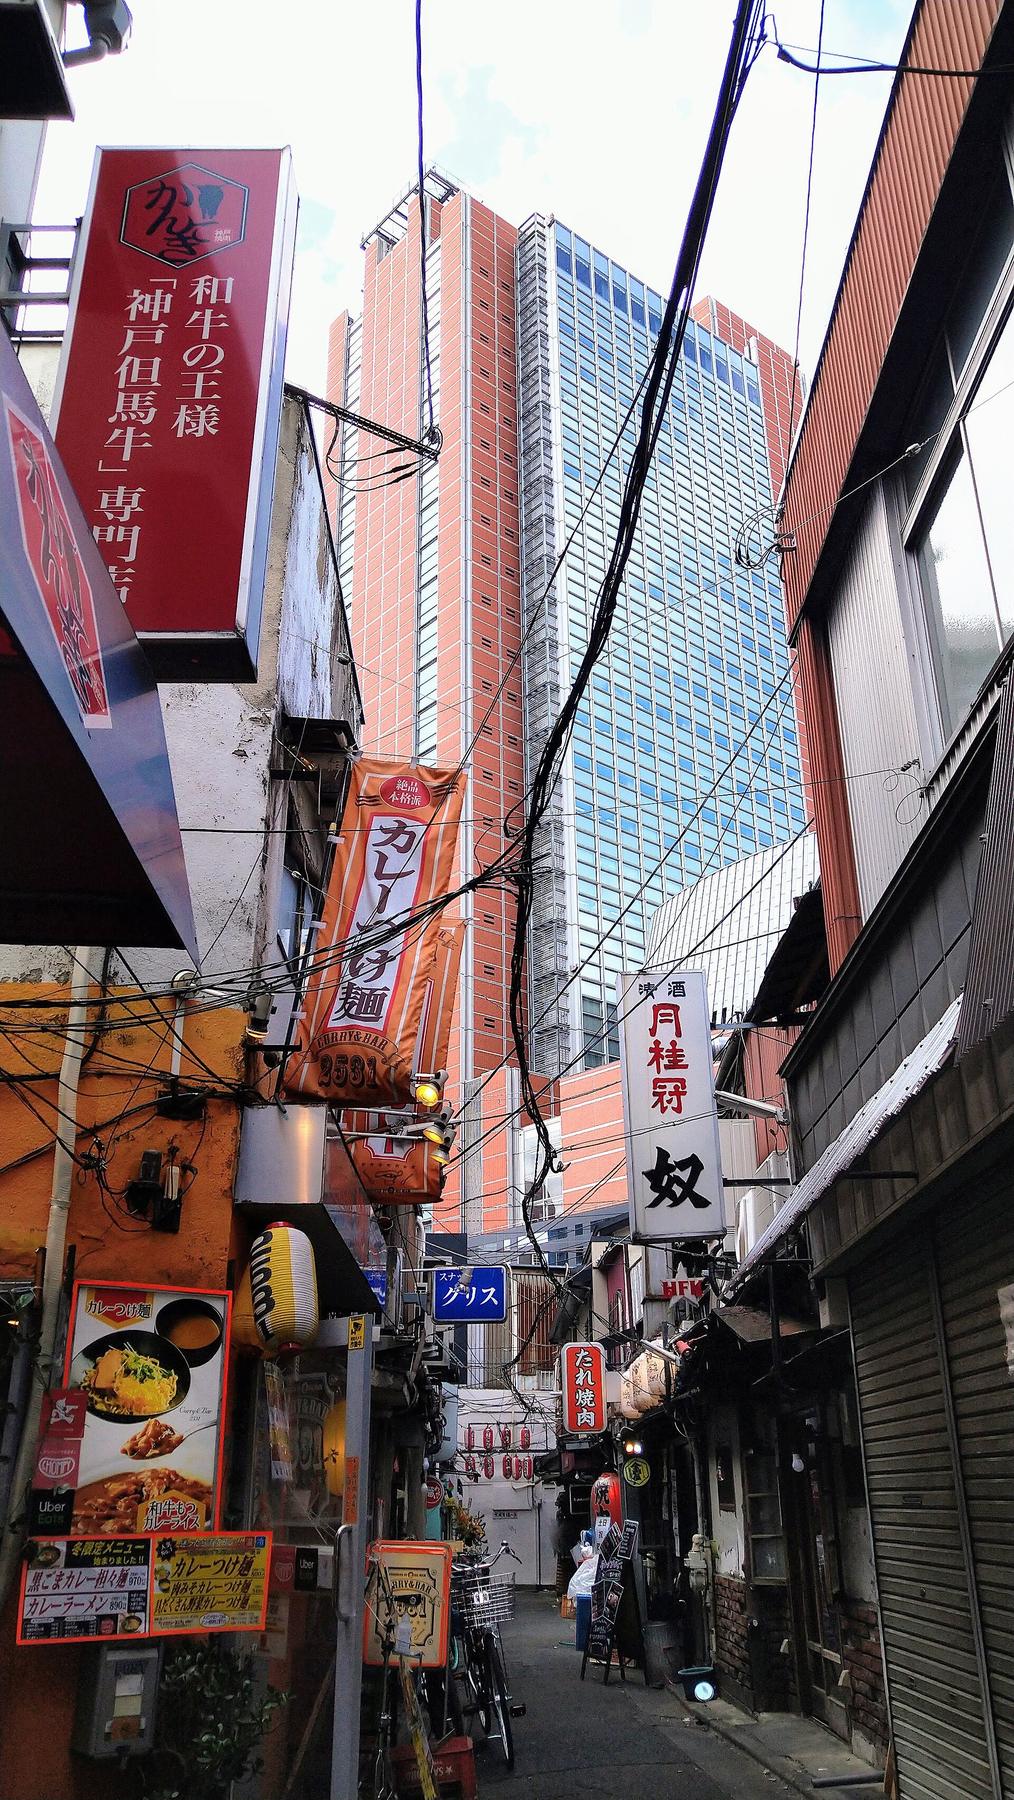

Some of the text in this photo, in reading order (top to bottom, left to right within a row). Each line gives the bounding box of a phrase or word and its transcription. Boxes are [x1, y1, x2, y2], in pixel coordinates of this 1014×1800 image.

[171, 274, 234, 438] 和牛の王様
[396, 779, 419, 793] 絶品
[388, 791, 422, 806] 本格派
[332, 820, 417, 1022] カレーつけ麺
[638, 980, 687, 999] 清酒
[647, 1003, 690, 1115] 月桂冠
[318, 1054, 378, 1089] 2531
[641, 1146, 713, 1209] 奴
[440, 1272, 474, 1281] スナッ
[88, 1300, 151, 1319] カレーつけ麺
[574, 1348, 597, 1428] たれ焼肉
[39, 1501, 65, 1513] Uber
[149, 1500, 196, 1517] 和牛もつ
[143, 1515, 199, 1531] カレーライス
[171, 1554, 255, 1578] カレーつけ麺
[26, 1596, 108, 1617] カレーラーメン
